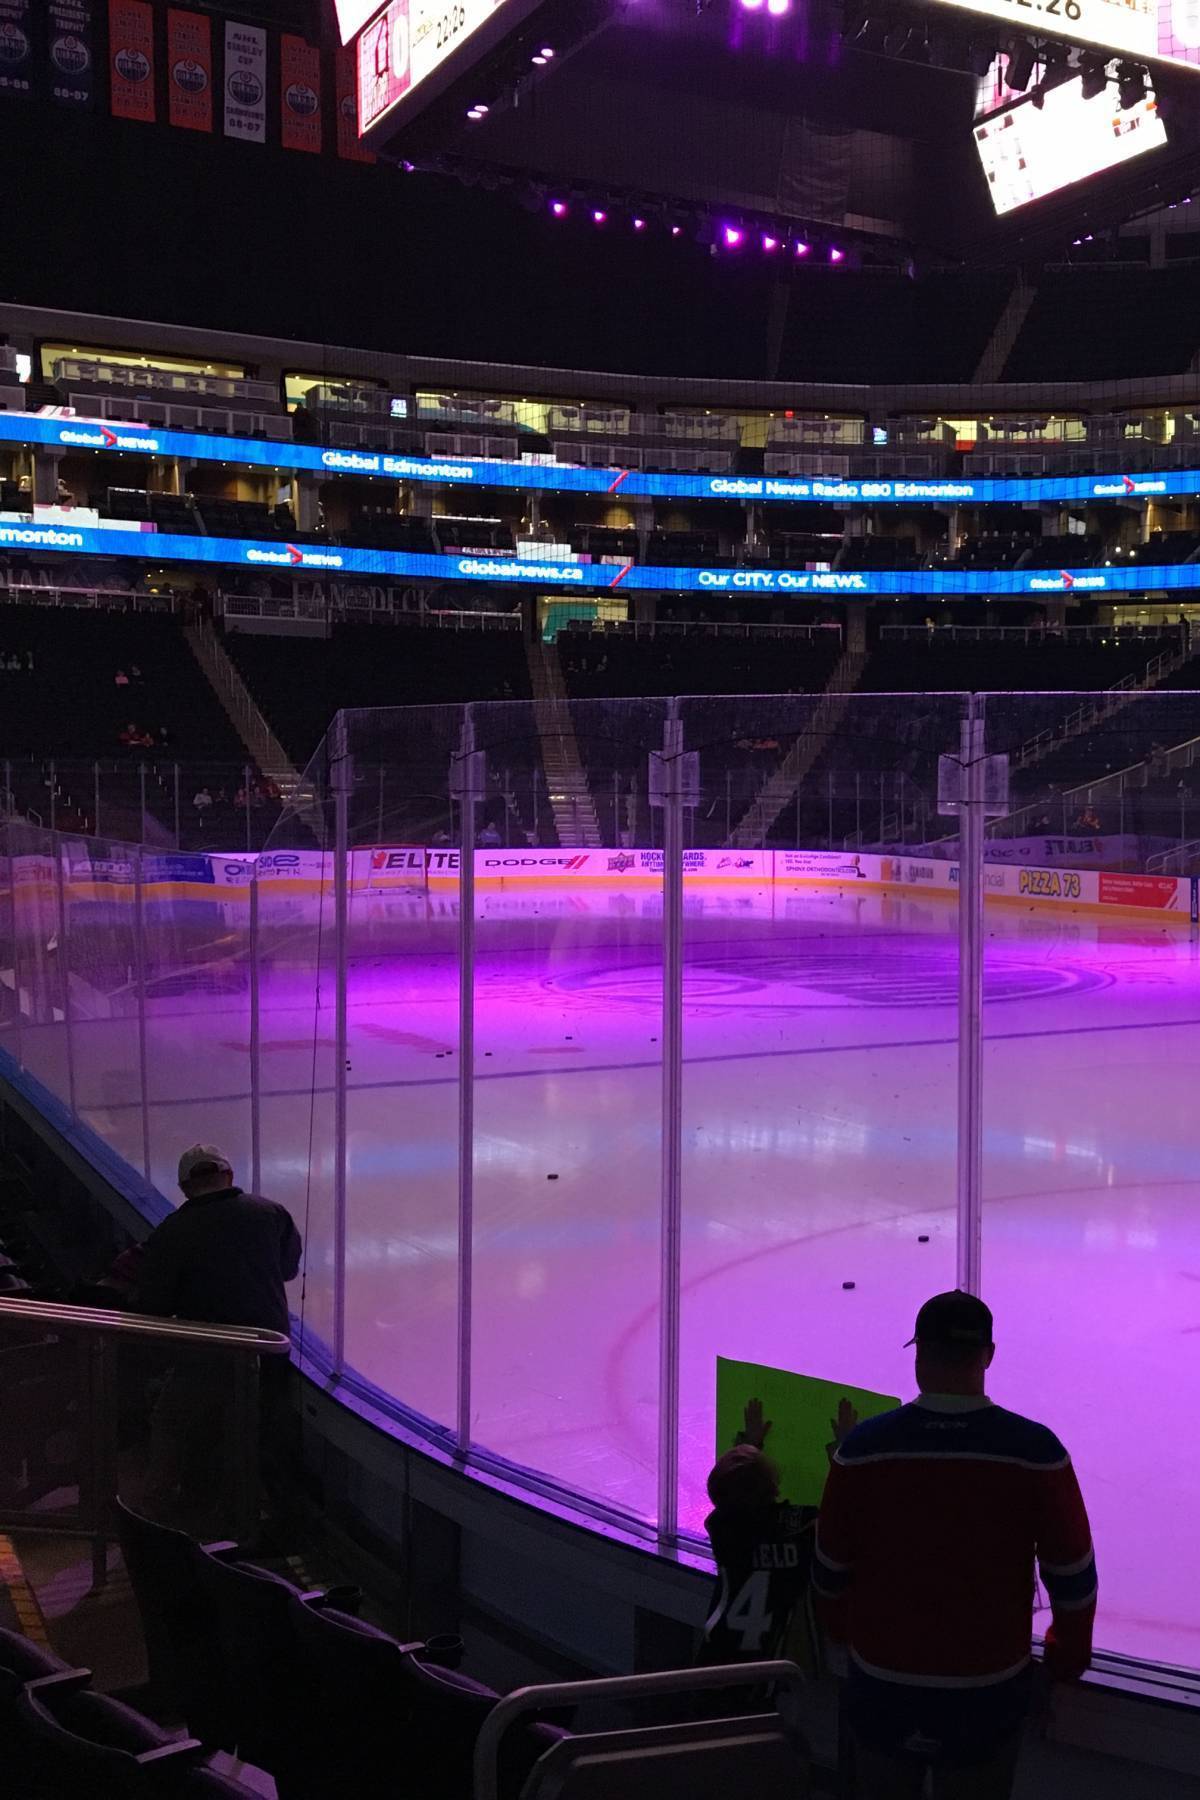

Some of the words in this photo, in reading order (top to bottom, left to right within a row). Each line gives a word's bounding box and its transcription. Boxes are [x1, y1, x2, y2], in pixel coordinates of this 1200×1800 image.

[60, 430, 104, 447] Global
[117, 437, 159, 452] NEWS
[322, 451, 380, 475] Global
[384, 455, 474, 480] Edmonton
[710, 477, 763, 496] Global
[766, 481, 810, 496] News
[812, 479, 858, 497] Radio
[895, 481, 974, 498] Edmonton
[1093, 484, 1126, 496] Global
[247, 548, 291, 564] Global
[302, 553, 343, 568] NEWS
[458, 558, 584, 581] Globalnews.ca
[698, 571, 730, 588] Our
[778, 573, 809, 589] Our
[1030, 577, 1064, 590] Global
[1073, 576, 1106, 588] NEWS
[485, 857, 571, 868] DODGE
[1020, 870, 1061, 896] PIZZA
[1062, 873, 1081, 898] 73
[726, 1570, 773, 1652] 4
